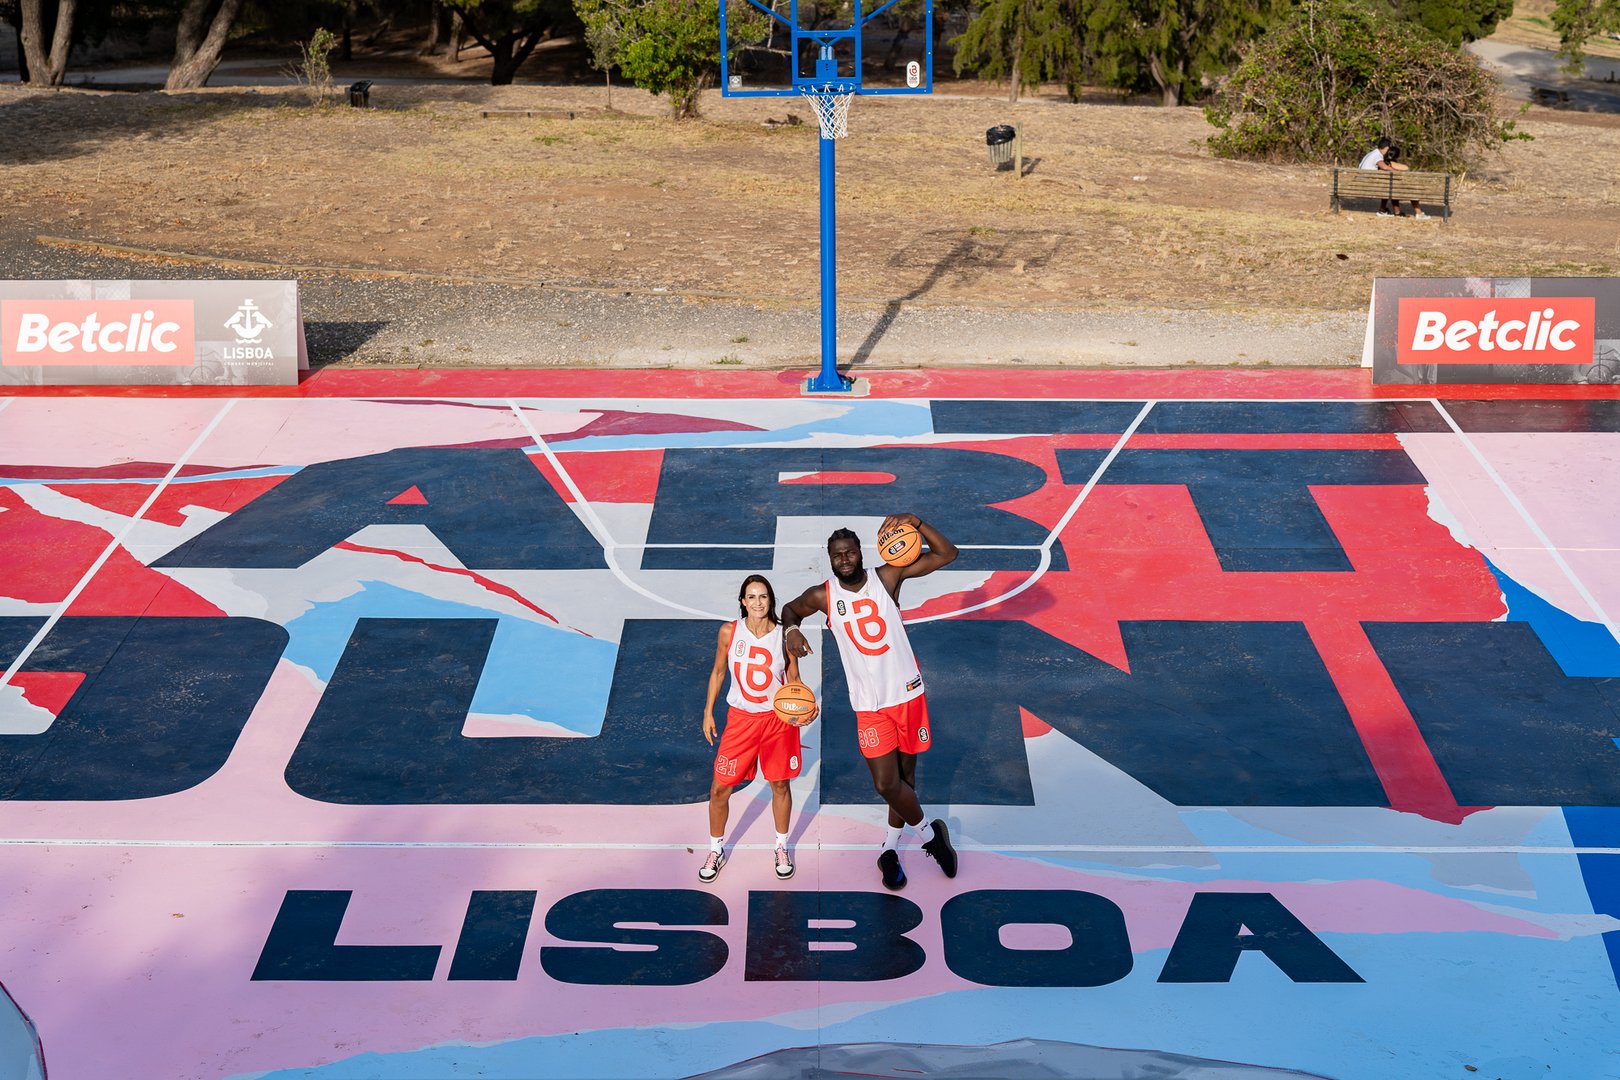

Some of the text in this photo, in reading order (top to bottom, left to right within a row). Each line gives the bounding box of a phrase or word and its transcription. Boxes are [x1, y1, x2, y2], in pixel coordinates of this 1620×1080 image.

[16, 309, 181, 353] Betclic
[1411, 307, 1581, 351] Betclic
[223, 347, 274, 359] LISBOA
[149, 447, 1428, 572] ART
[716, 755, 737, 776] 21
[250, 889, 1367, 987] LISBOA
